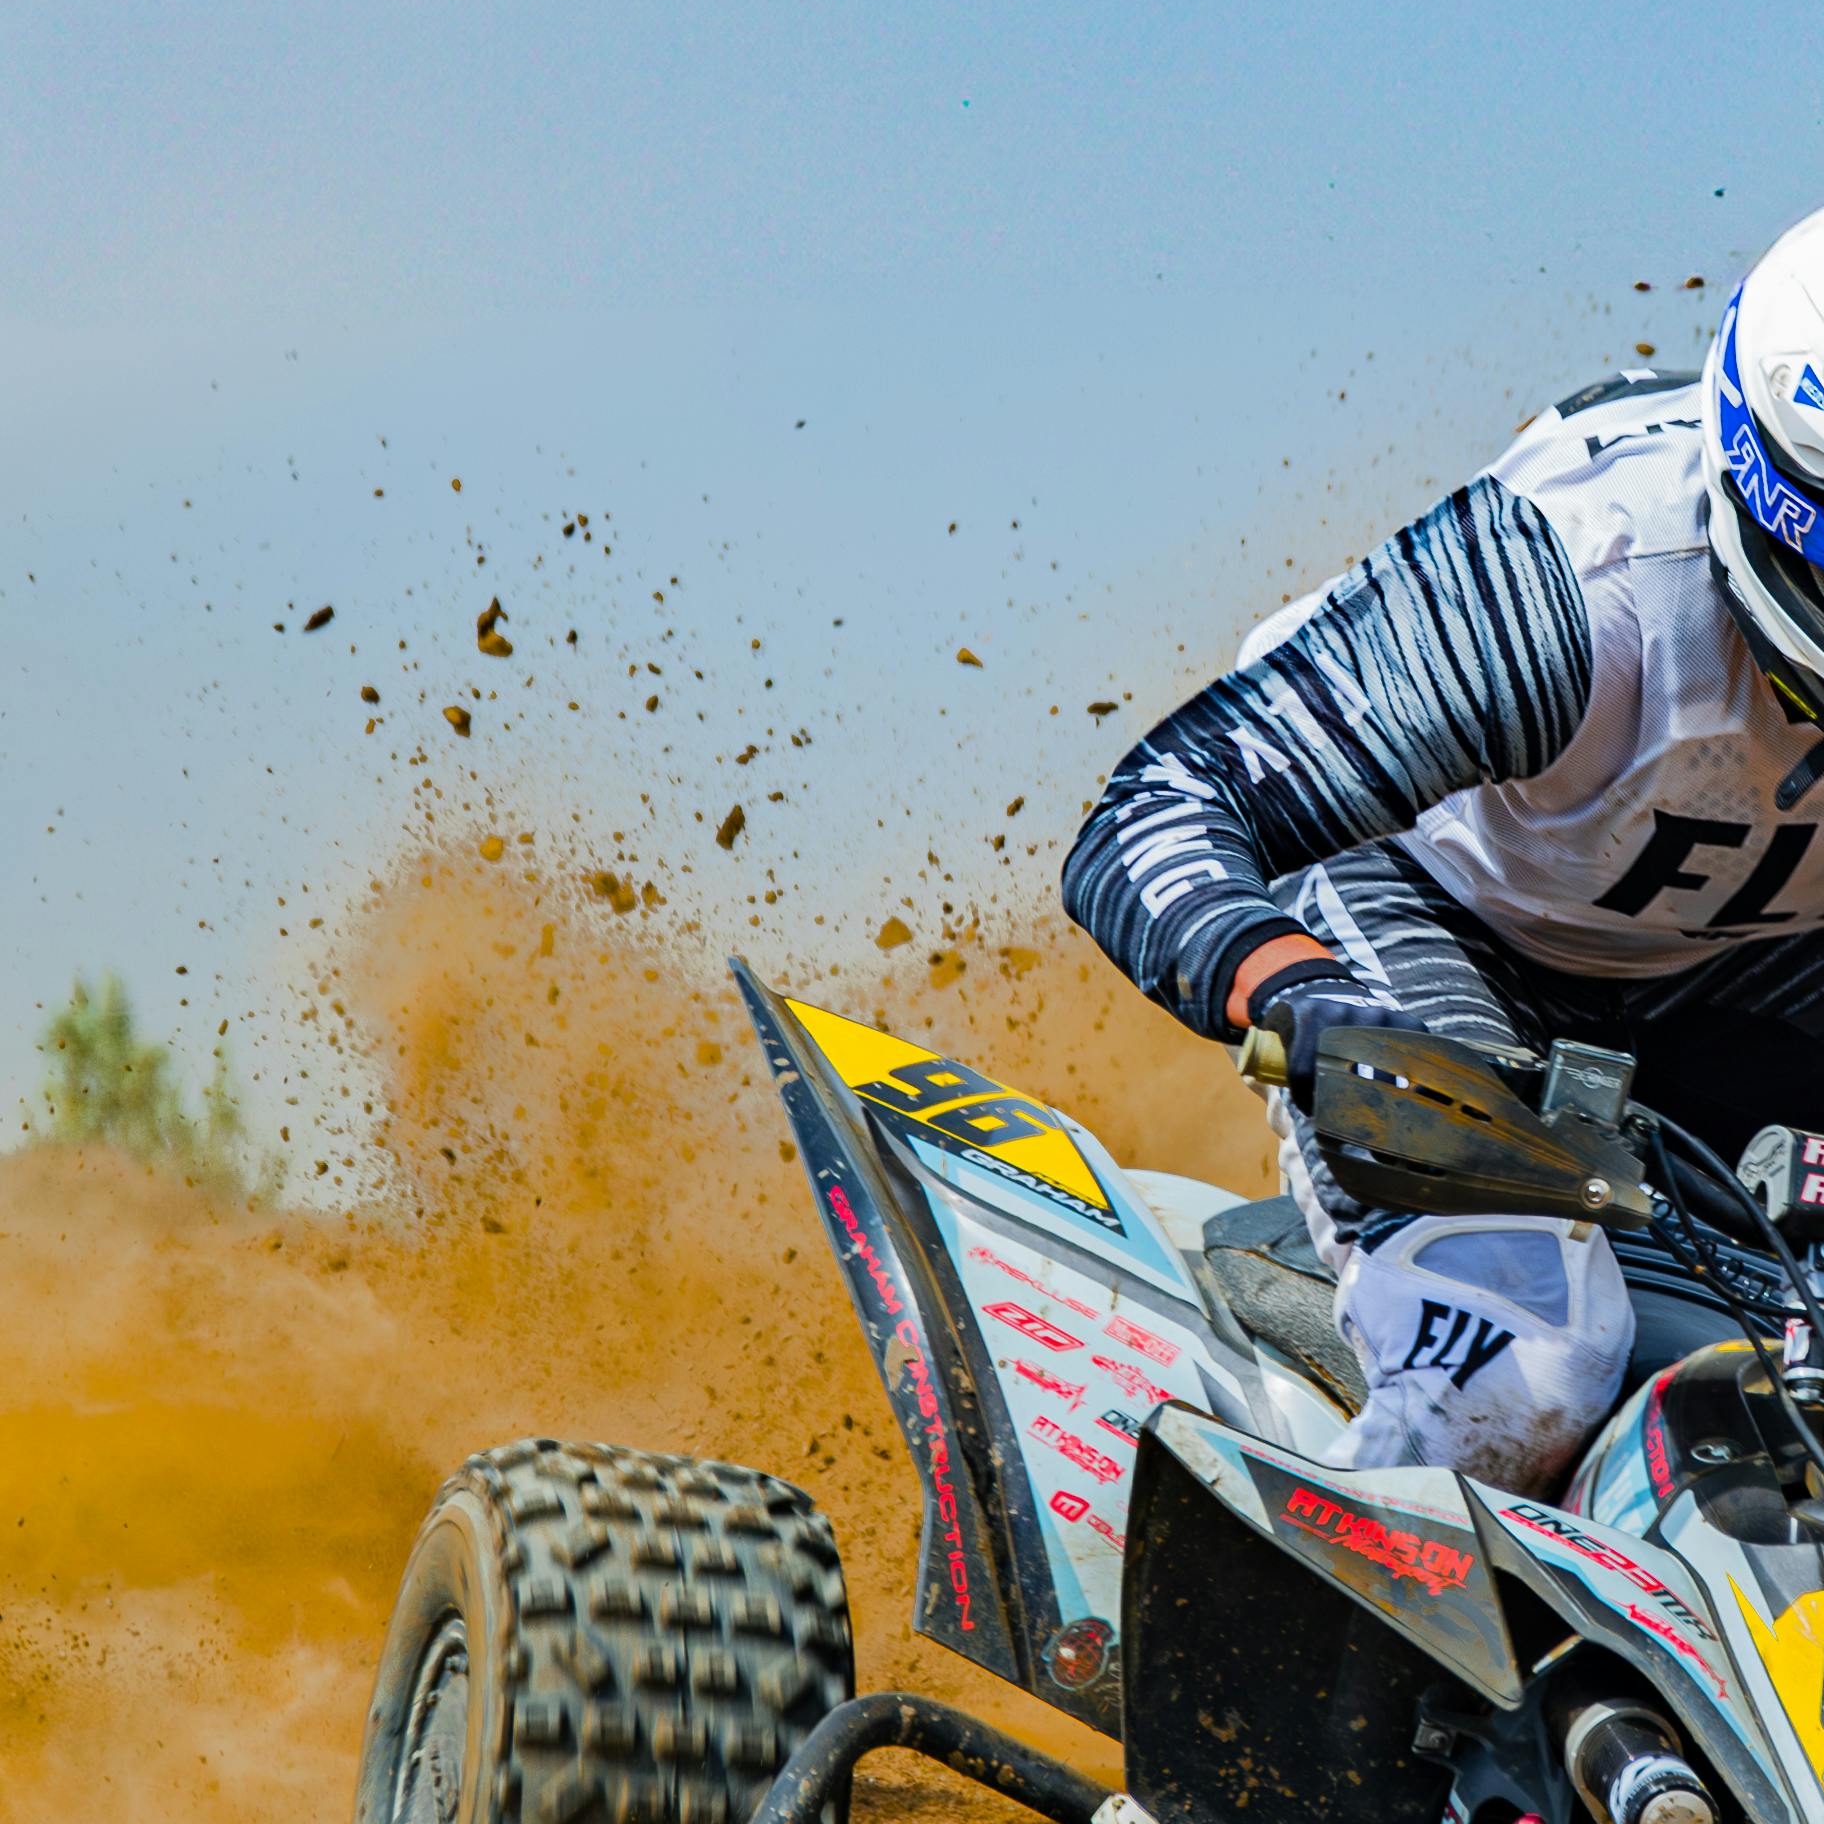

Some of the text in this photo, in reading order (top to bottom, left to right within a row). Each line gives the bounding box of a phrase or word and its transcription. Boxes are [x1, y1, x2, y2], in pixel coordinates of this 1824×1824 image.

[960, 1148, 1121, 1227] GRAHAM
[828, 1184, 904, 1315] GRAHAM
[1404, 1298, 1517, 1391] FLY
[1031, 1415, 1126, 1480] ATKINSON
[1285, 1487, 1475, 1582] ATKINSON
